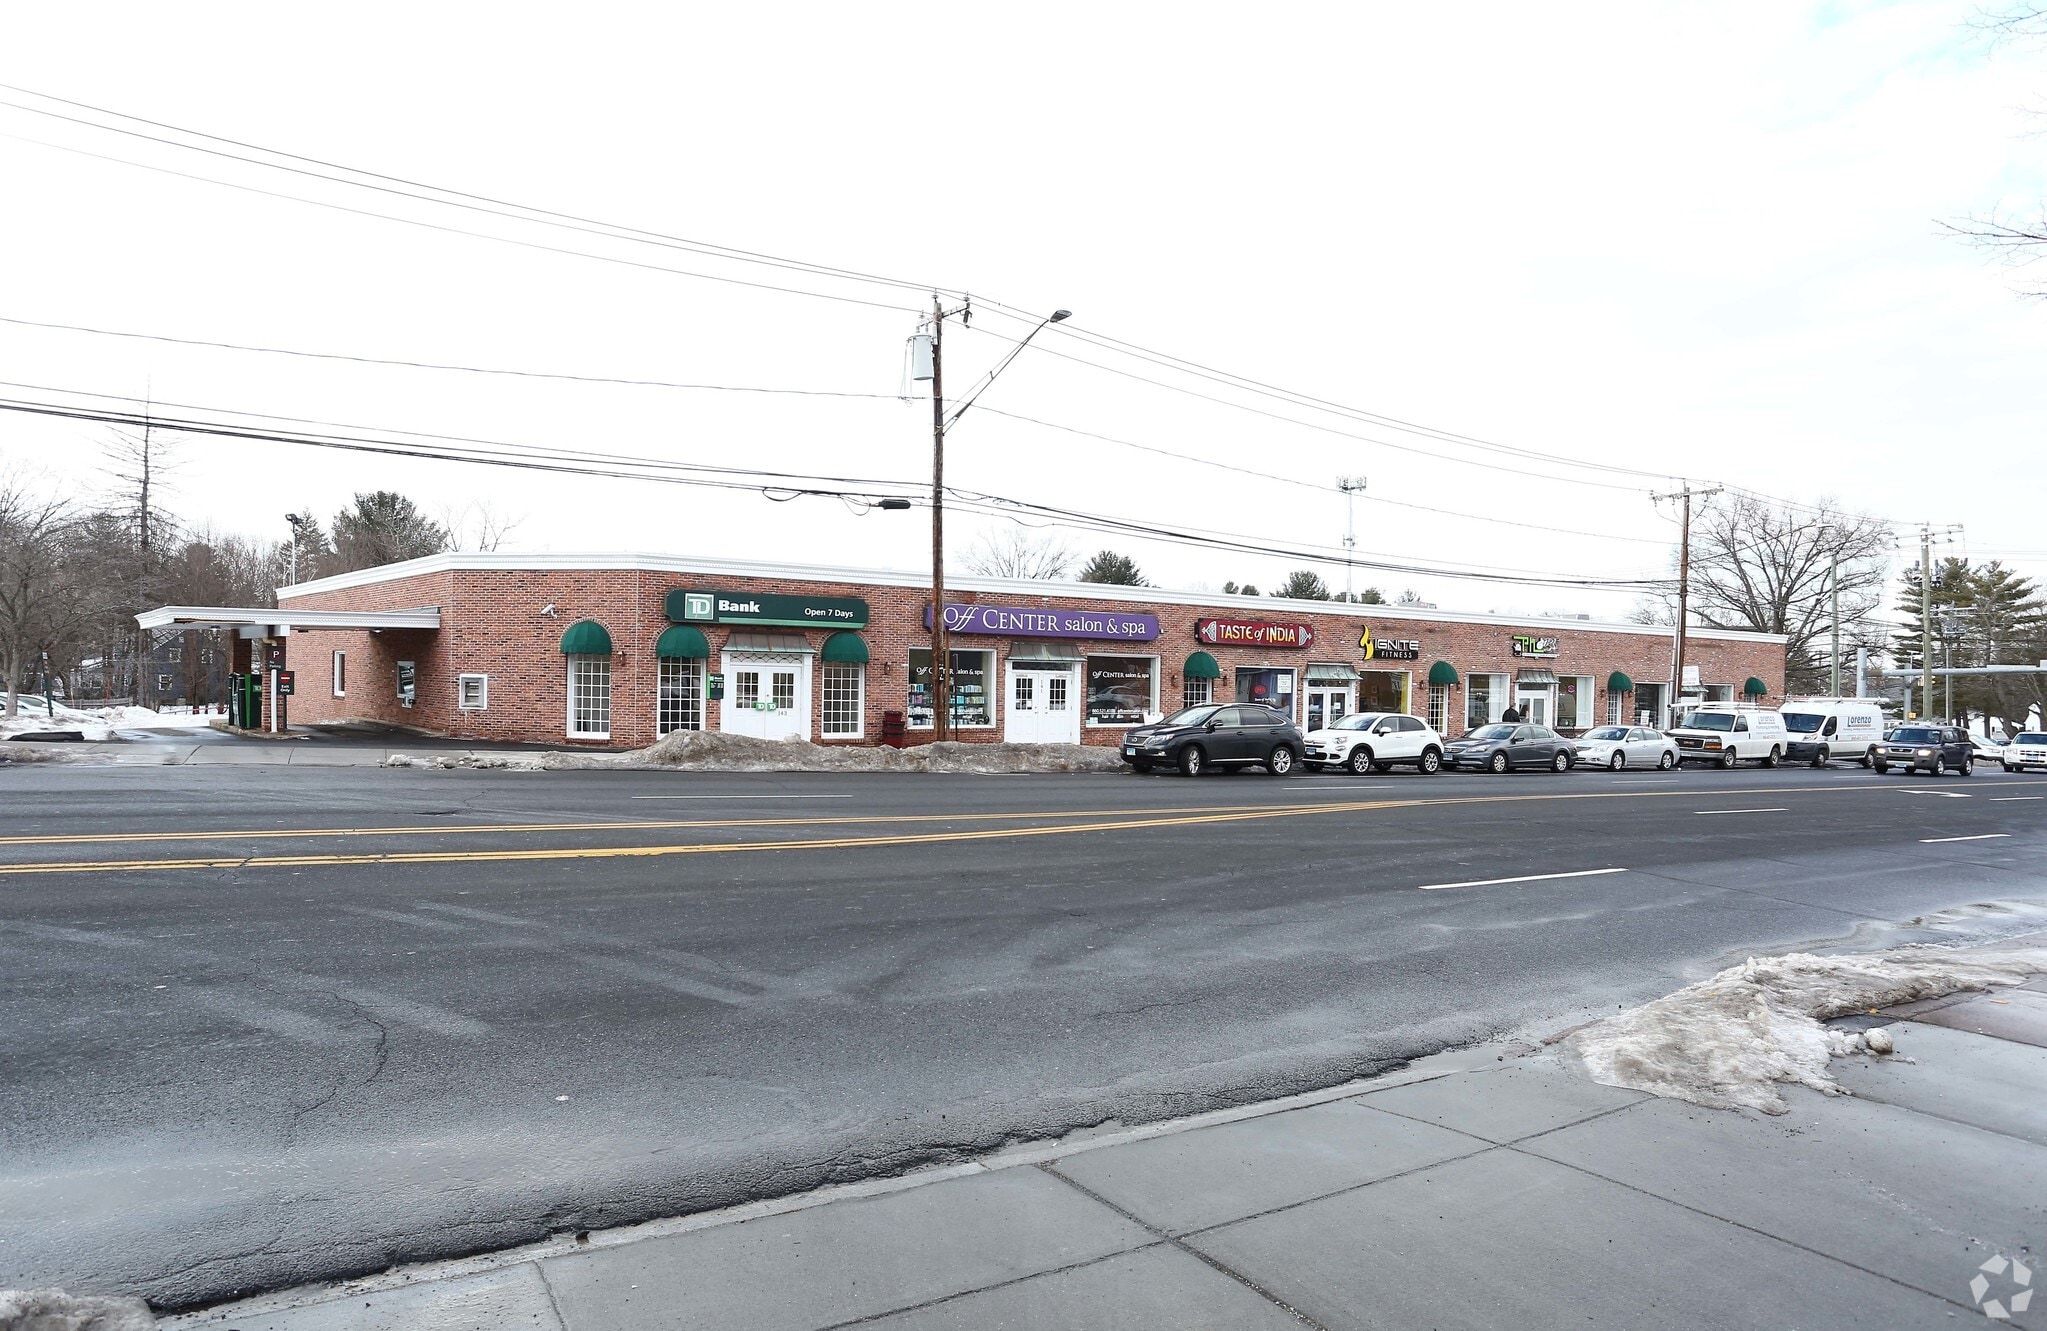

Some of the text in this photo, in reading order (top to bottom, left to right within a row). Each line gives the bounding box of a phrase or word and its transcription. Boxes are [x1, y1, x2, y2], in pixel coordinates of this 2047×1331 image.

[688, 598, 760, 615] TD Bank
[804, 608, 826, 618] Open
[834, 609, 854, 618] Days
[943, 606, 1146, 637] Off CENTER salon & spa
[1219, 624, 1296, 643] TASTE of INDIA
[1374, 639, 1419, 650] IGNITE
[273, 650, 280, 658] P
[1381, 651, 1412, 659] FITNESS
[1847, 716, 1872, 728] Lorenzo
